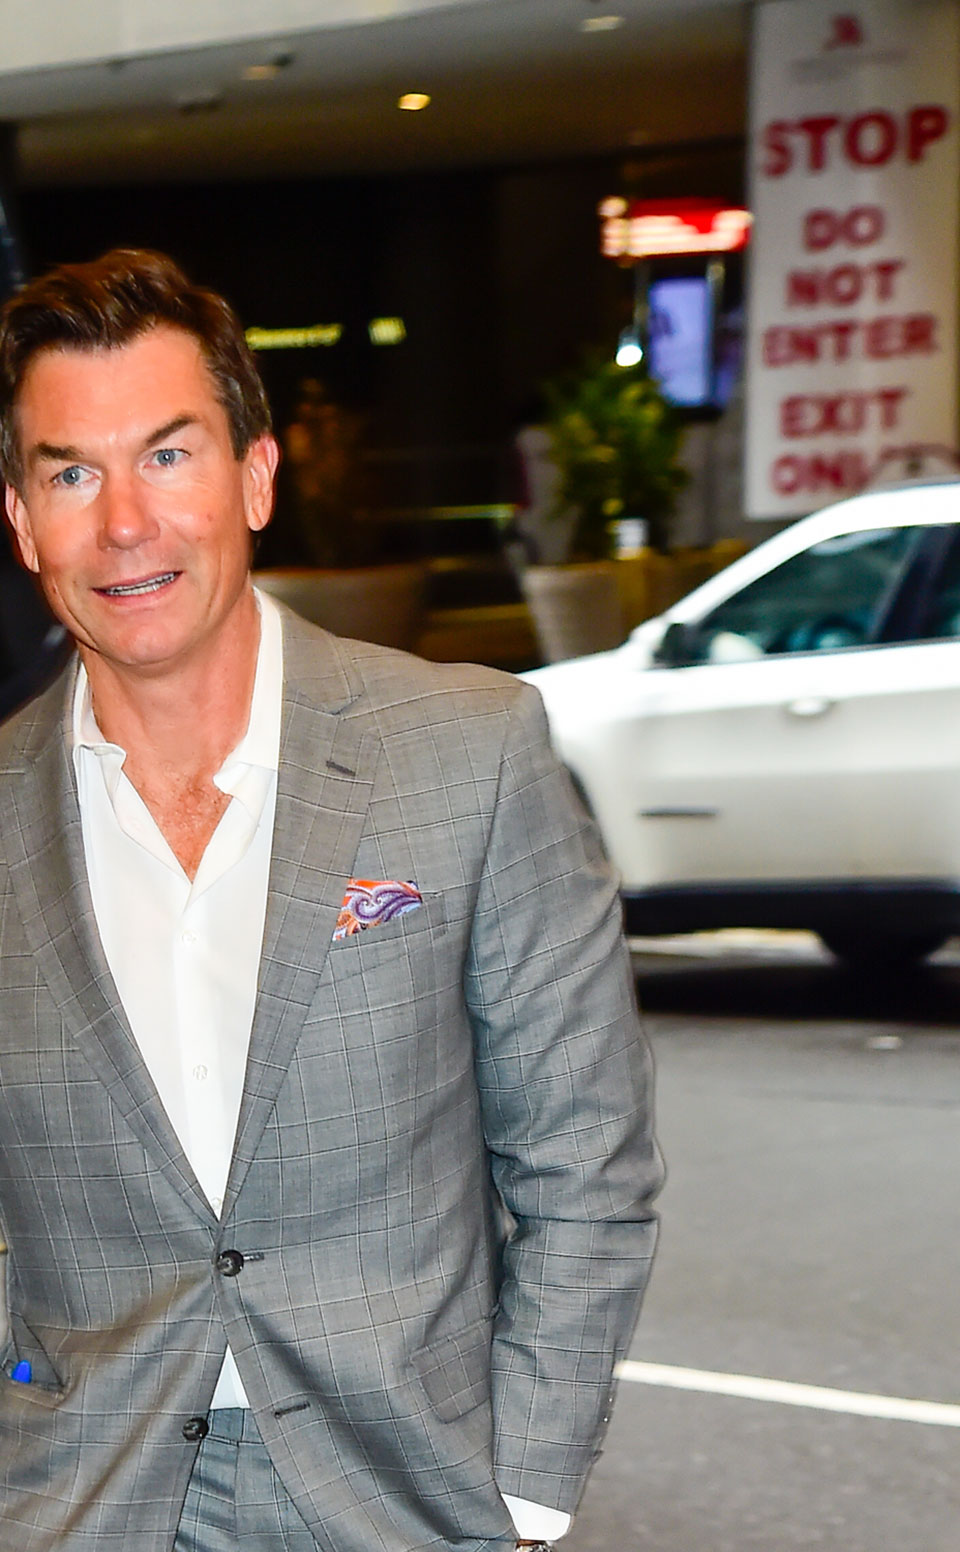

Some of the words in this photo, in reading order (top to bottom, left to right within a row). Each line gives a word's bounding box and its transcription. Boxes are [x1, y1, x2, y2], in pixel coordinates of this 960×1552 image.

[764, 105, 948, 178] STOP
[804, 208, 885, 253] DO
[788, 259, 905, 307] NOT
[763, 314, 938, 368] ENTER
[780, 386, 910, 440] EXIT
